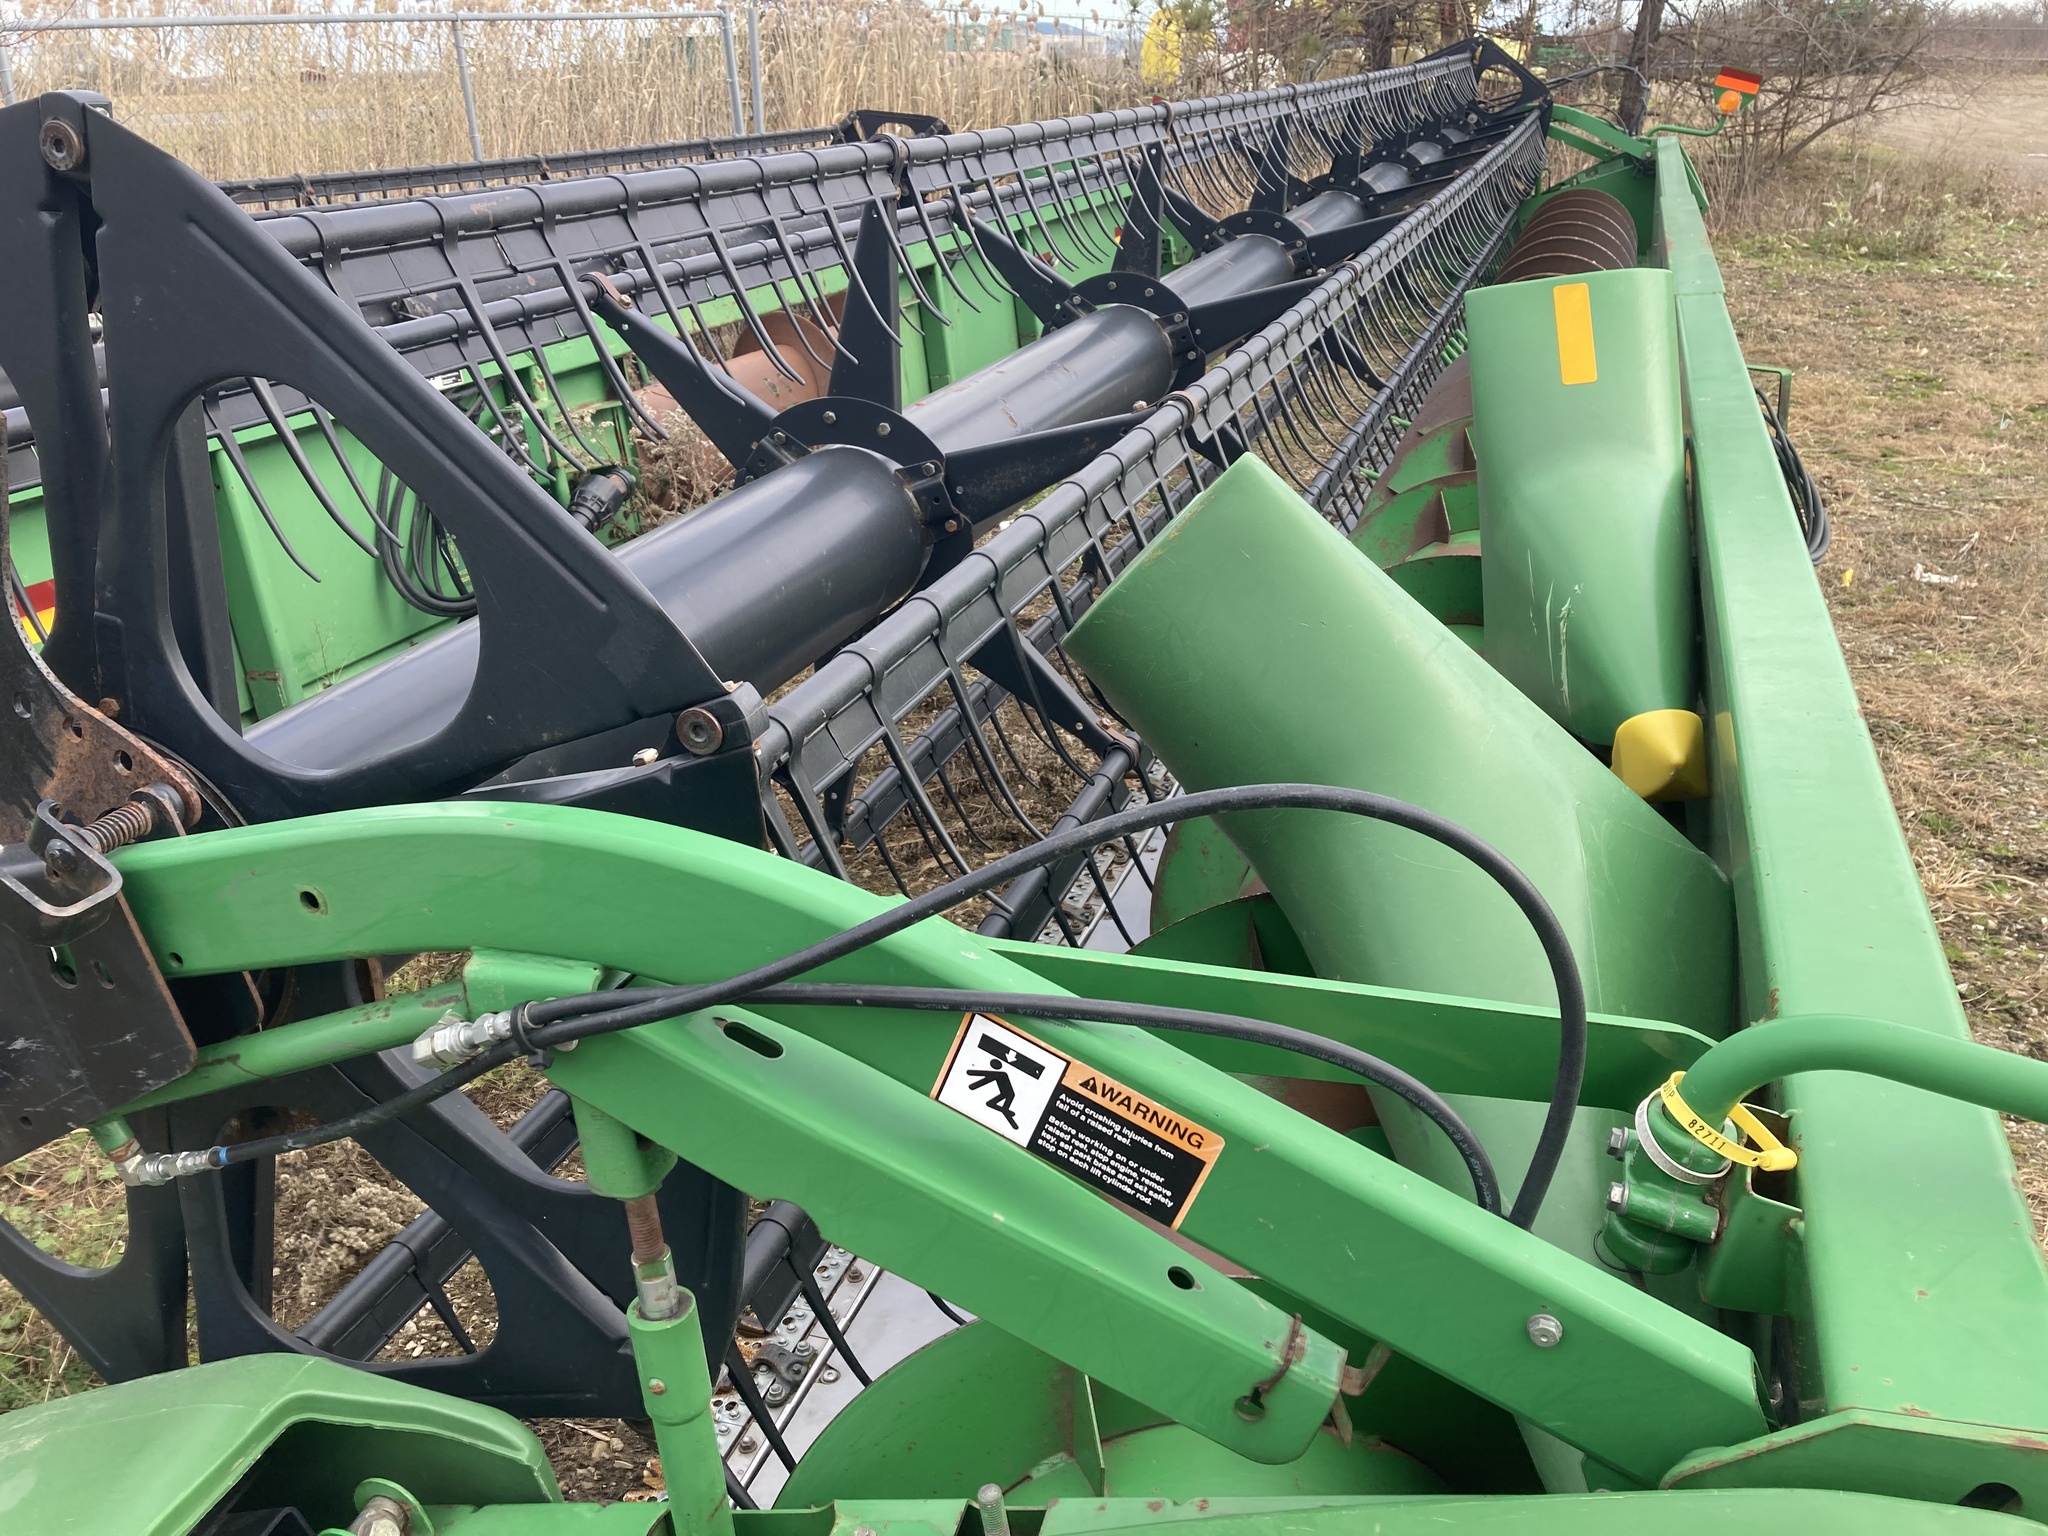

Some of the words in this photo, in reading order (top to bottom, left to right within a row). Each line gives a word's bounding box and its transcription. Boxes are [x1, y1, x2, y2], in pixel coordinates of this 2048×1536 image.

[1048, 1115, 1076, 1135] Before
[1078, 1132, 1113, 1156] working
[1115, 1153, 1126, 1162] on
[1127, 1160, 1138, 1168] or
[1139, 1166, 1164, 1182] under
[1055, 1100, 1069, 1111] fall
[1069, 1109, 1080, 1117] of
[1086, 1118, 1113, 1135] raised
[1113, 1132, 1130, 1146] reel.
[1058, 1093, 1084, 1110] Avoid
[1084, 1107, 1121, 1131] crushing
[1121, 1126, 1153, 1148] injuries
[1154, 1144, 1174, 1159] from
[1100, 1082, 1204, 1149] WARNING
[1688, 1119, 1727, 1150] 82711
[1037, 1138, 1056, 1151] stop
[1056, 1149, 1068, 1158] on
[1068, 1155, 1089, 1170] each
[1089, 1166, 1101, 1177] lift
[1102, 1174, 1135, 1195] cylinder
[1135, 1192, 1151, 1205] rod.
[1040, 1129, 1057, 1144] key,
[1059, 1141, 1072, 1152] set
[1072, 1148, 1092, 1162] park
[1092, 1158, 1116, 1175] brake
[1116, 1172, 1133, 1185] and
[1133, 1182, 1147, 1193] set
[1147, 1189, 1173, 1207] safety
[1044, 1123, 1070, 1141] raised
[1070, 1138, 1088, 1152] reel,
[1090, 1148, 1108, 1162] stop
[1109, 1159, 1138, 1180] engine,
[1140, 1176, 1171, 1196] remove
